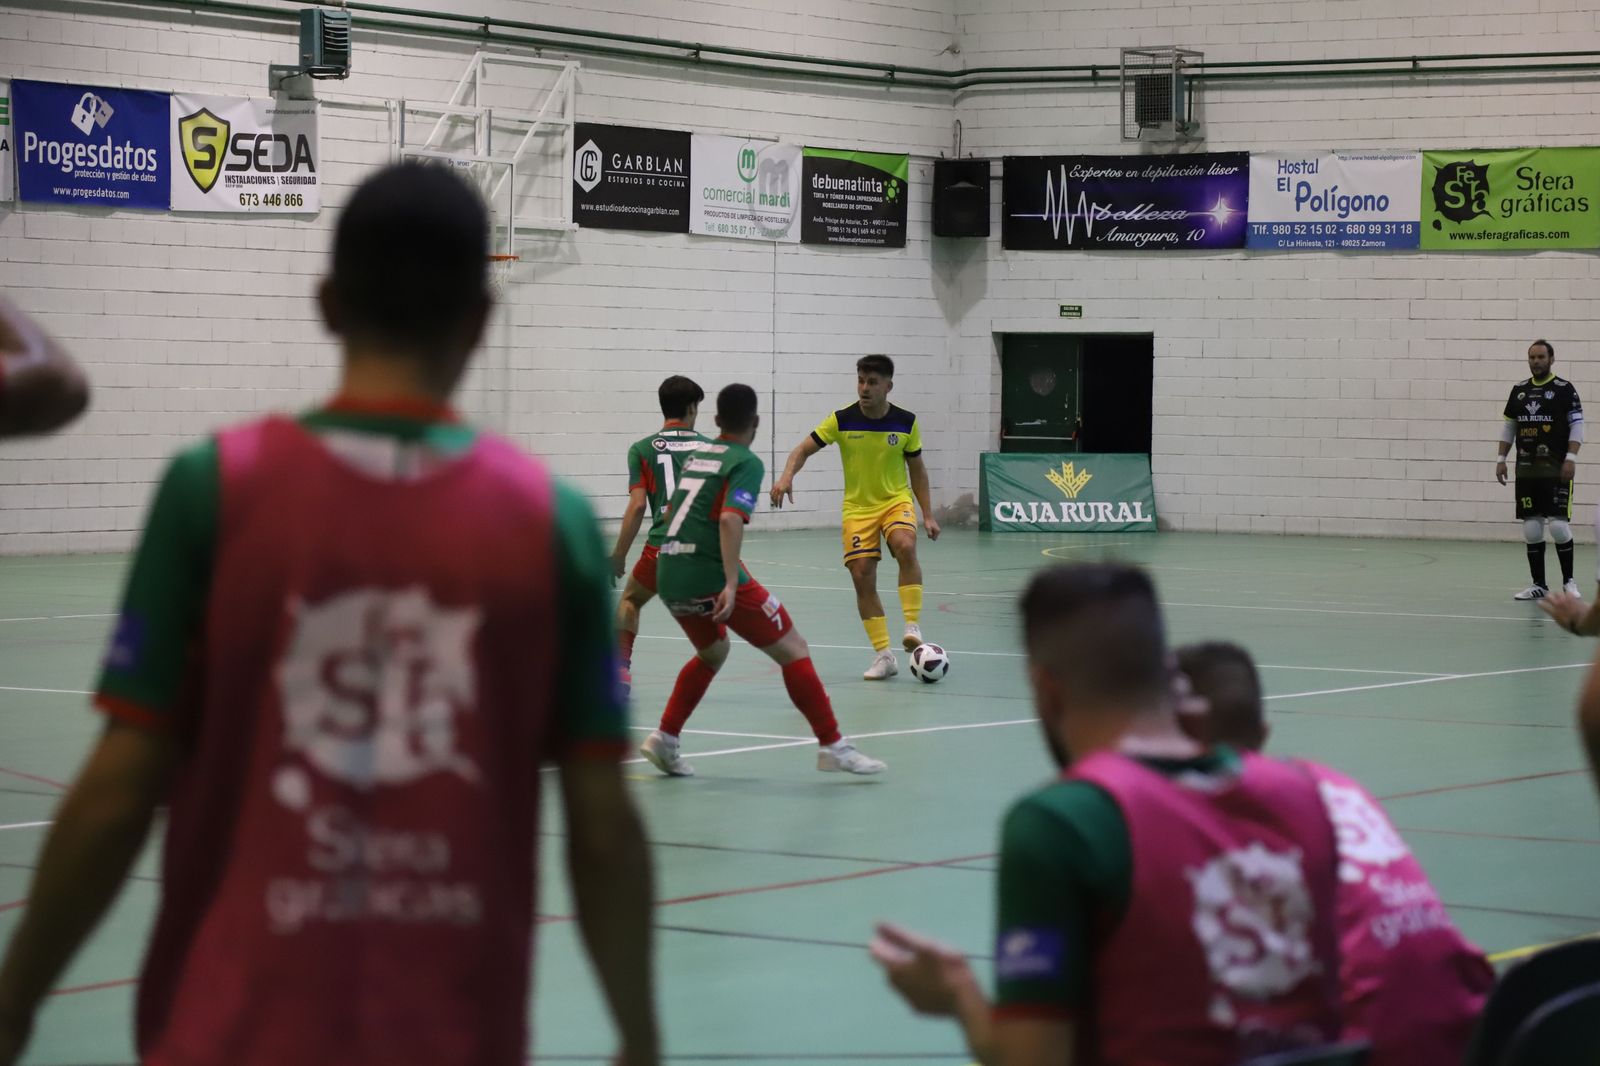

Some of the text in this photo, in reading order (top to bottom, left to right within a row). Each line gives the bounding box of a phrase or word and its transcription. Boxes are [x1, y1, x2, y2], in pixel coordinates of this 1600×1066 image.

[24, 132, 158, 172] Progesdatos
[224, 132, 316, 172] SEDA
[612, 153, 682, 174] GARBLAN
[1070, 162, 1239, 182] Expertos en depilación láser
[1278, 158, 1318, 174] Hostal
[74, 169, 105, 178] protección
[112, 170, 130, 180] gestión
[131, 172, 138, 181] de
[140, 173, 156, 182] datos
[224, 175, 276, 184] INSTALACIONES
[280, 176, 316, 185] SEGURIDAD
[608, 176, 642, 184] ESTUDIOS
[658, 180, 685, 188] COCINA
[812, 173, 882, 192] debuenatinta
[1516, 166, 1574, 191] Sfera
[53, 186, 130, 198] www.progesdatos.com
[240, 193, 303, 206] 673 446 866
[703, 187, 790, 208] comercial mardi
[1277, 177, 1390, 218] El Polígono
[581, 204, 680, 216] www.estudiosdecocinagarblan.com
[704, 210, 730, 218] PRODUCTOS
[1095, 203, 1188, 221] belleza
[1500, 193, 1589, 218] gráficas
[730, 225, 738, 234] 35
[749, 227, 756, 236] 17
[1096, 226, 1206, 248] Amargura, 10
[1252, 224, 1269, 234] Tlf.
[1272, 224, 1291, 234] 980
[1294, 224, 1306, 234] 52
[1310, 224, 1322, 234] 15
[1325, 224, 1337, 234] 02
[1346, 224, 1366, 234] 680
[1368, 224, 1381, 234] 99
[1384, 224, 1396, 234] 31
[1400, 224, 1412, 234] 18
[1450, 229, 1570, 241] www.sferagraficas.com
[1520, 428, 1538, 436] AMOR
[666, 478, 706, 536] 7
[1522, 498, 1532, 508] 13
[994, 501, 1152, 524] CAJA RURAL
[852, 536, 861, 548] 2
[771, 612, 783, 631] 7
